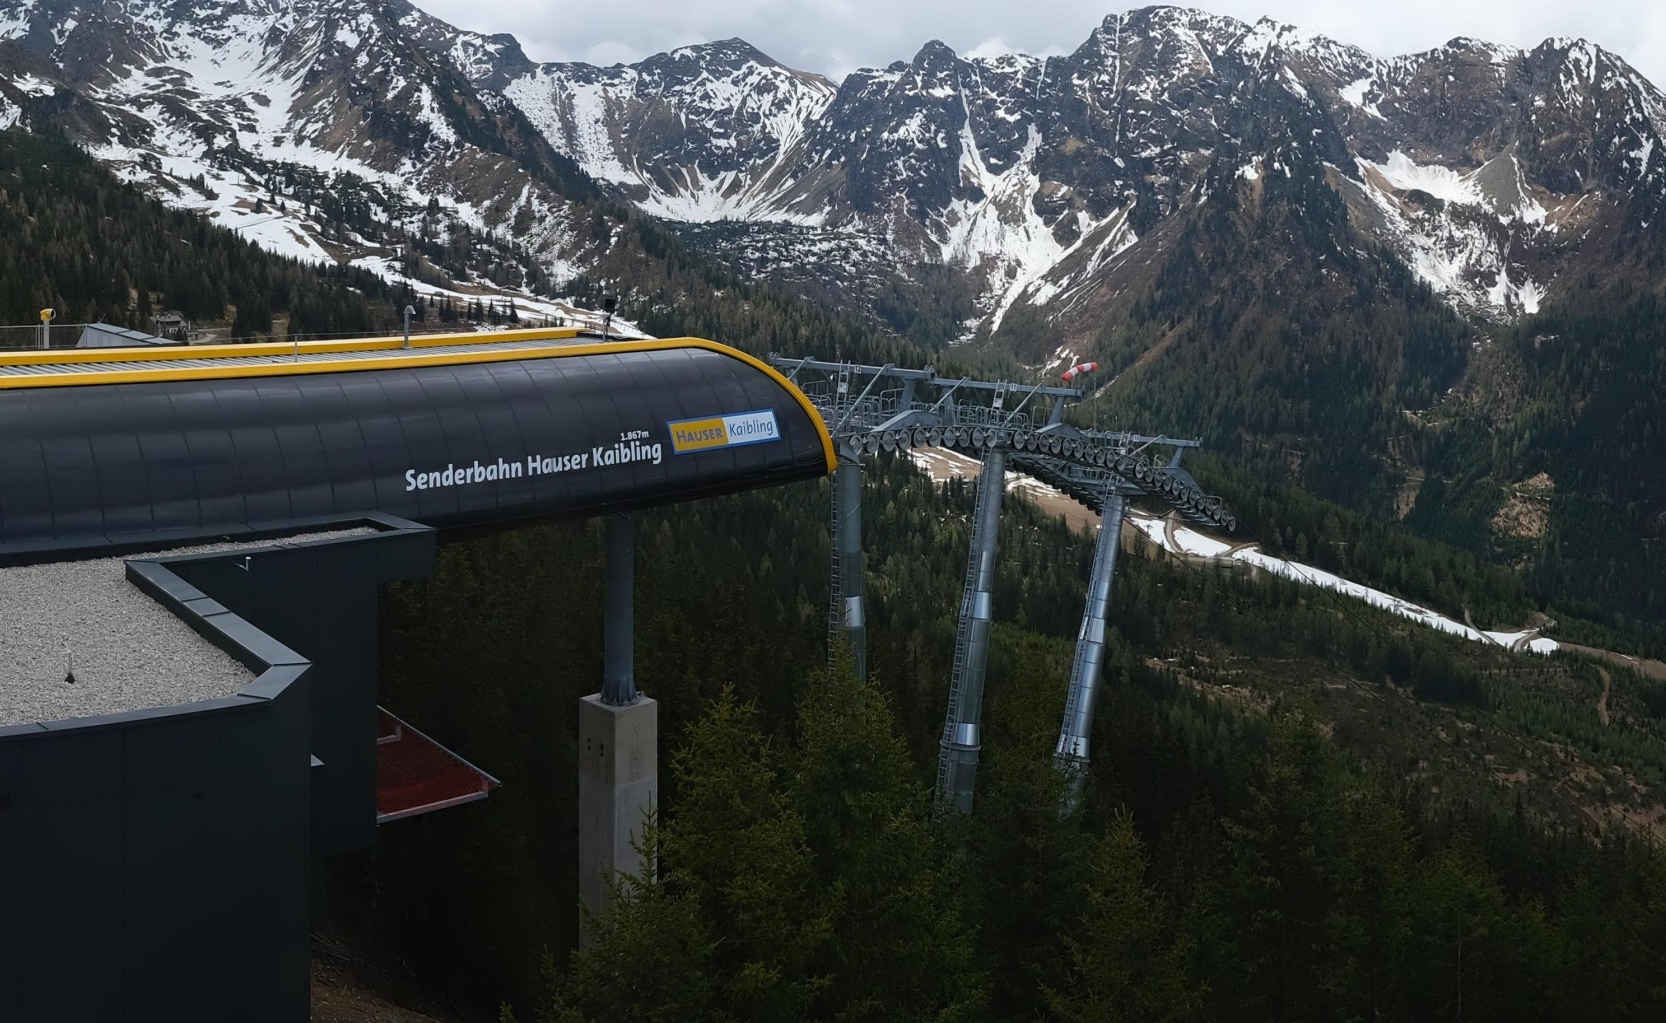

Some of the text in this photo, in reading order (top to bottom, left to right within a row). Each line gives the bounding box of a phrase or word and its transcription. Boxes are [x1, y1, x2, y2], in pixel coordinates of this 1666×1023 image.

[620, 430, 649, 441] 1.867m
[675, 420, 774, 444] HAUSER Kaibling
[405, 441, 662, 492] Senderbahn Hauser Kaibling
